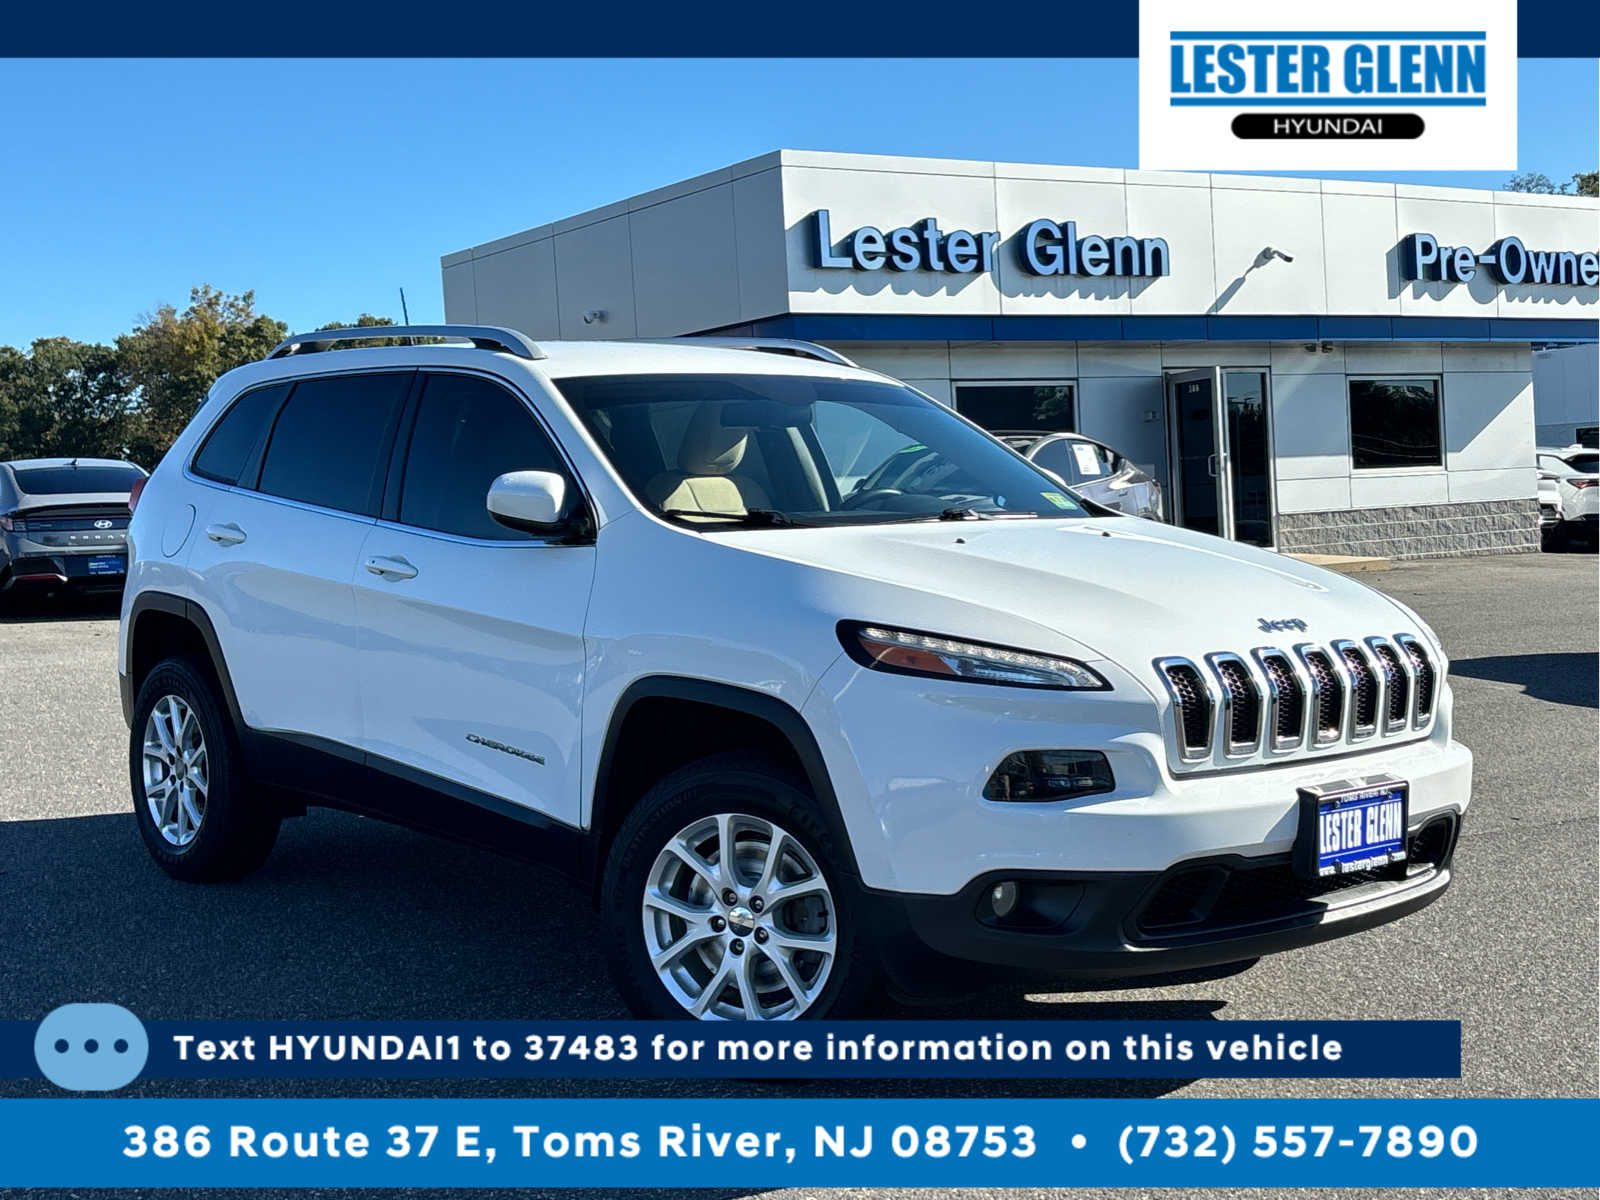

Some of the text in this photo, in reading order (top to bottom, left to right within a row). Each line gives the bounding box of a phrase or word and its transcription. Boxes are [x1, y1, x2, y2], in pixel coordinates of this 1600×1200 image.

[816, 209, 1170, 277] Lester Glenn
[1257, 618, 1308, 633] Jeep
[465, 733, 545, 766] CHEROKEE
[1319, 801, 1402, 854] LESTER GLENN
